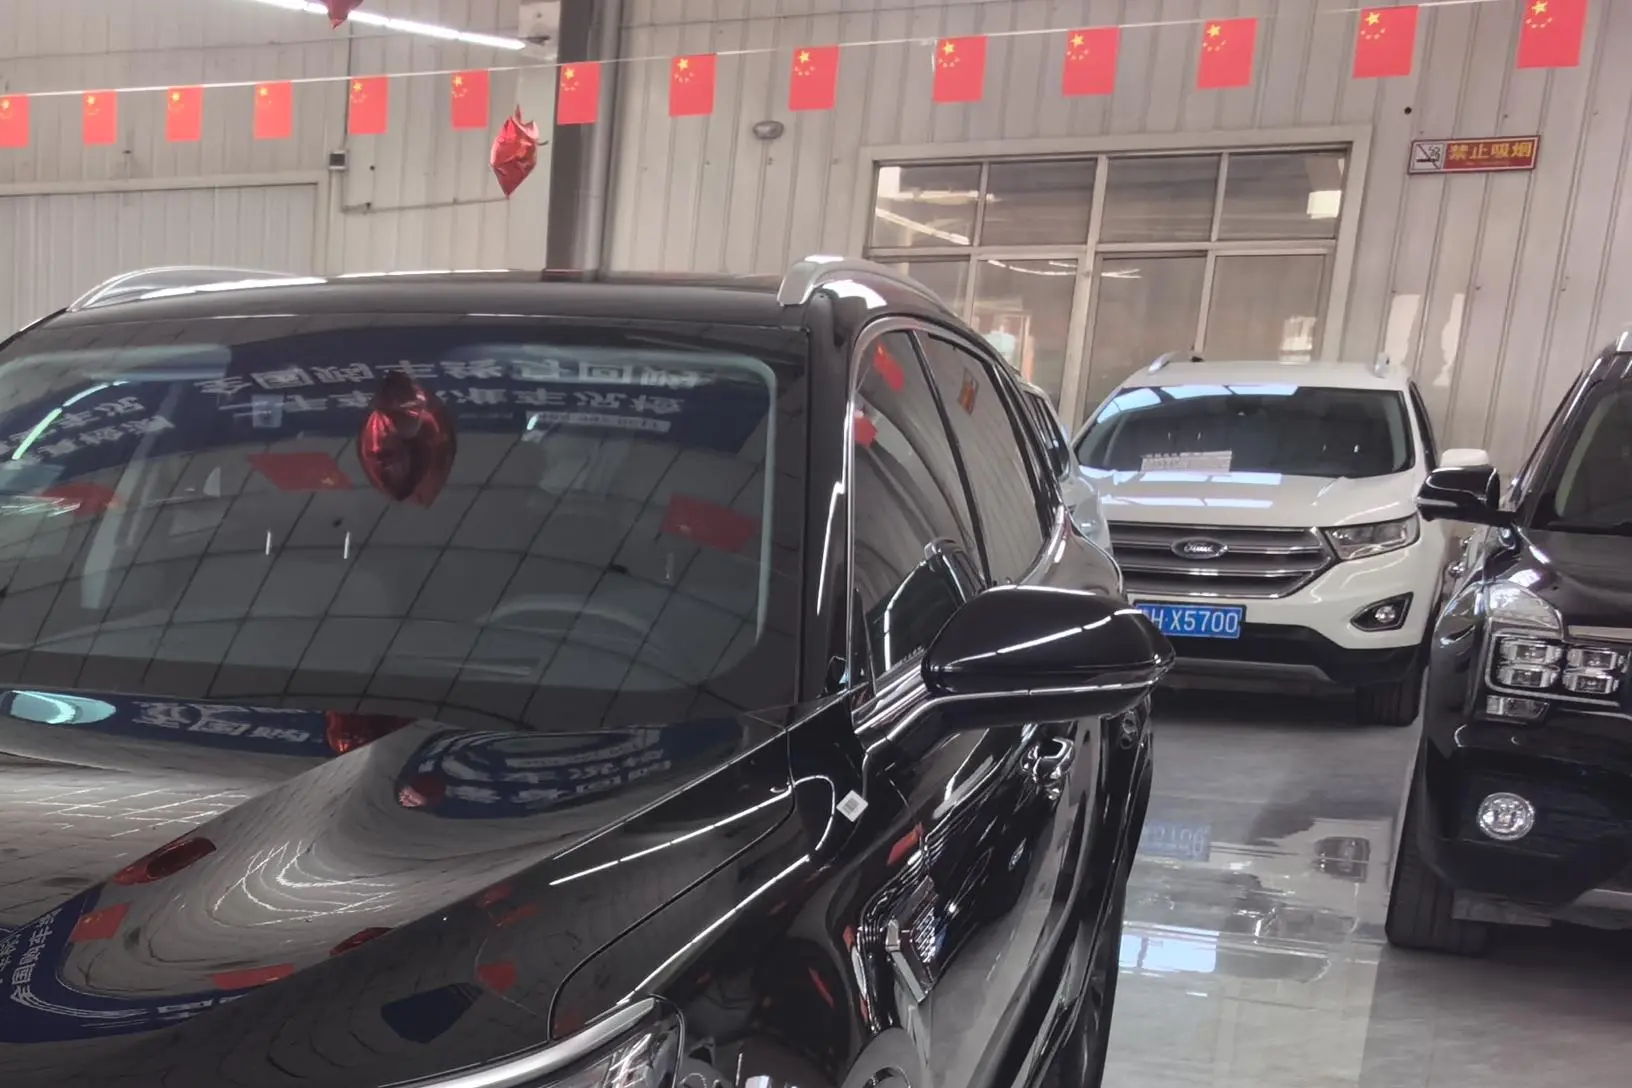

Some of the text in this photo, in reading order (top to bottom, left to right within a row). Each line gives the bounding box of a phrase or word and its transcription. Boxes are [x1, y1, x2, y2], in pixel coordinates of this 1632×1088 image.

[1448, 141, 1532, 160] 禁止吸烟
[1142, 606, 1238, 633] H·X5700
